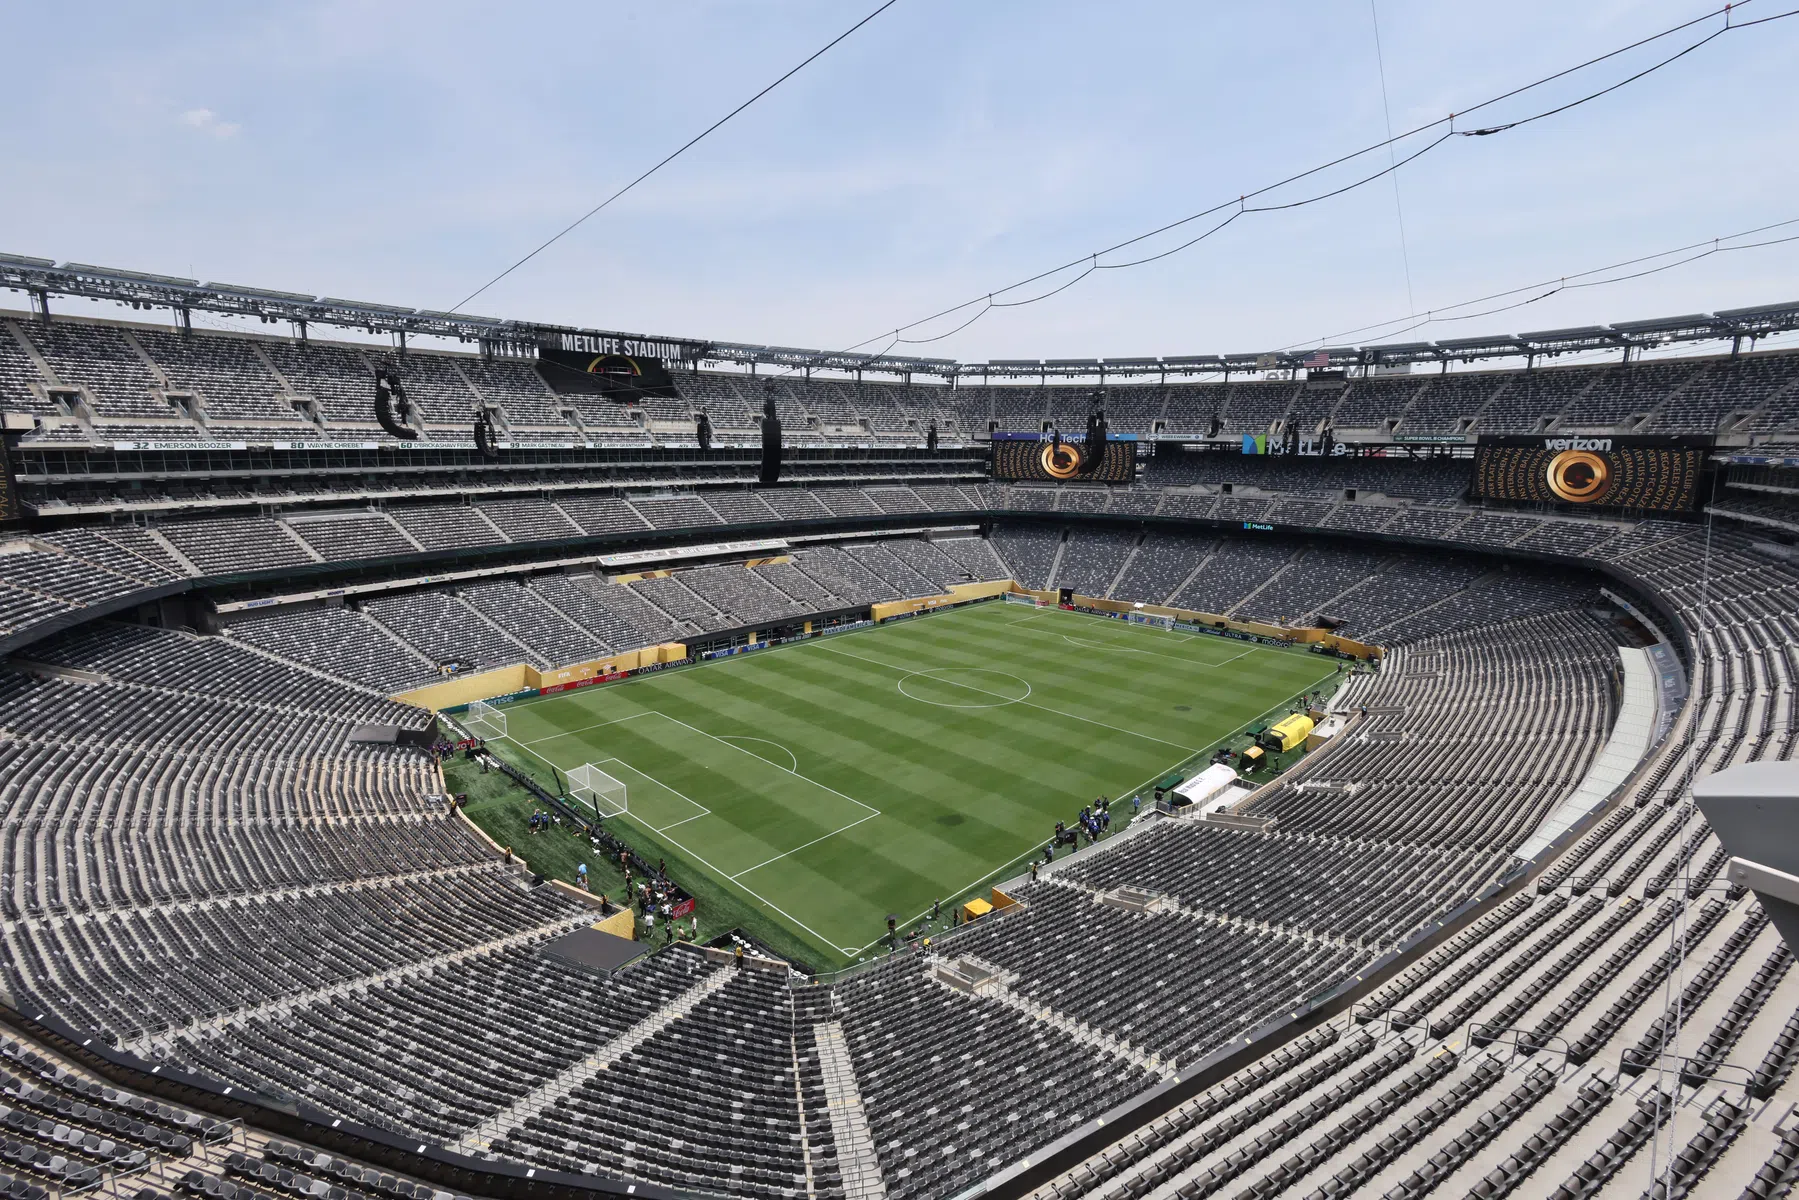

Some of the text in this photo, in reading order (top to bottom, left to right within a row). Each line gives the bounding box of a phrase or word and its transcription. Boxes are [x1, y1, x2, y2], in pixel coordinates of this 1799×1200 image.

[561, 333, 680, 360] METLIFE STADIUM
[1040, 434, 1087, 443] HCTech
[1545, 436, 1612, 451] verizon
[1488, 463, 1496, 481] PLATE
[1621, 449, 1633, 483] GERMAIN
[1660, 452, 1669, 484] REGATAS
[1672, 452, 1681, 485] ANGELES
[1479, 460, 1487, 492] AUCKLAND
[1647, 477, 1656, 487] FC
[1684, 470, 1694, 489] CLUB
[1656, 484, 1665, 496] DO
[638, 658, 693, 675] QATAR AIRWAYS
